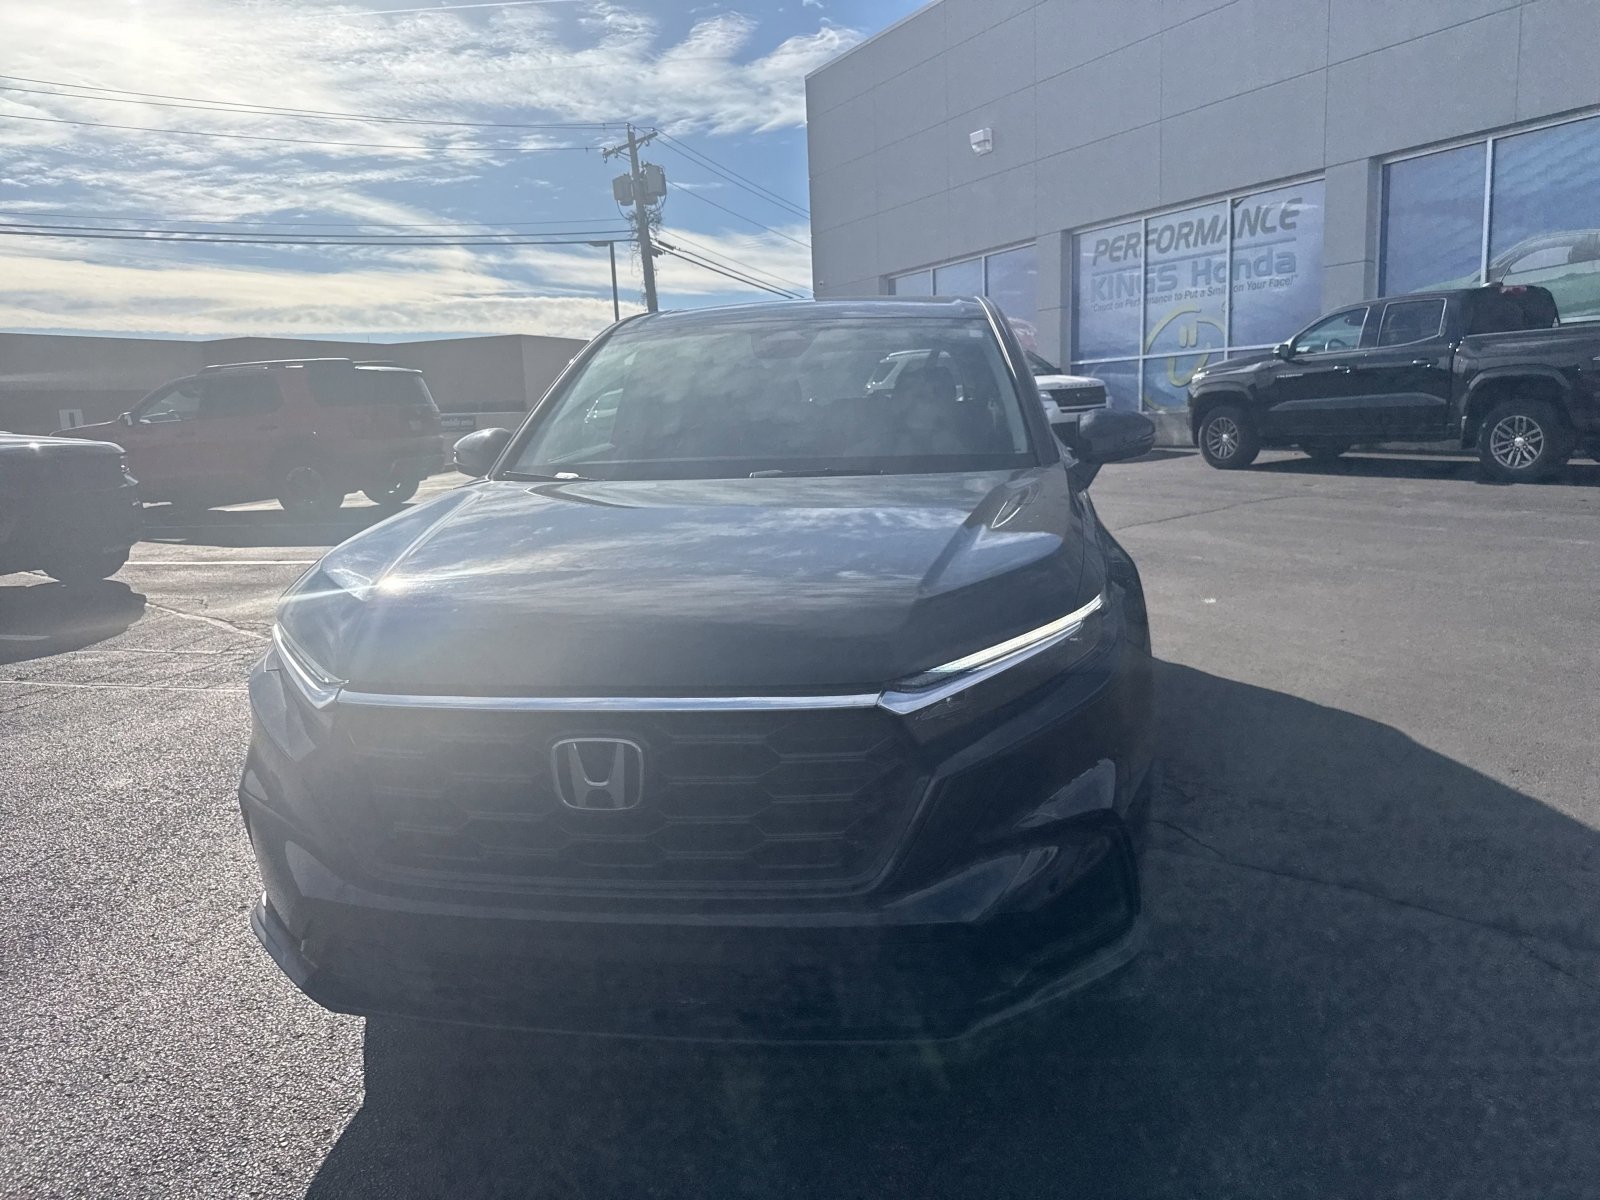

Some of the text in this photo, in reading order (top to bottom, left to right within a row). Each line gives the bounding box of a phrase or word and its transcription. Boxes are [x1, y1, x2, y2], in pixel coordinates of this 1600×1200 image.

[1091, 248, 1297, 303] KINGS Honda
[1247, 280, 1267, 290] Your
